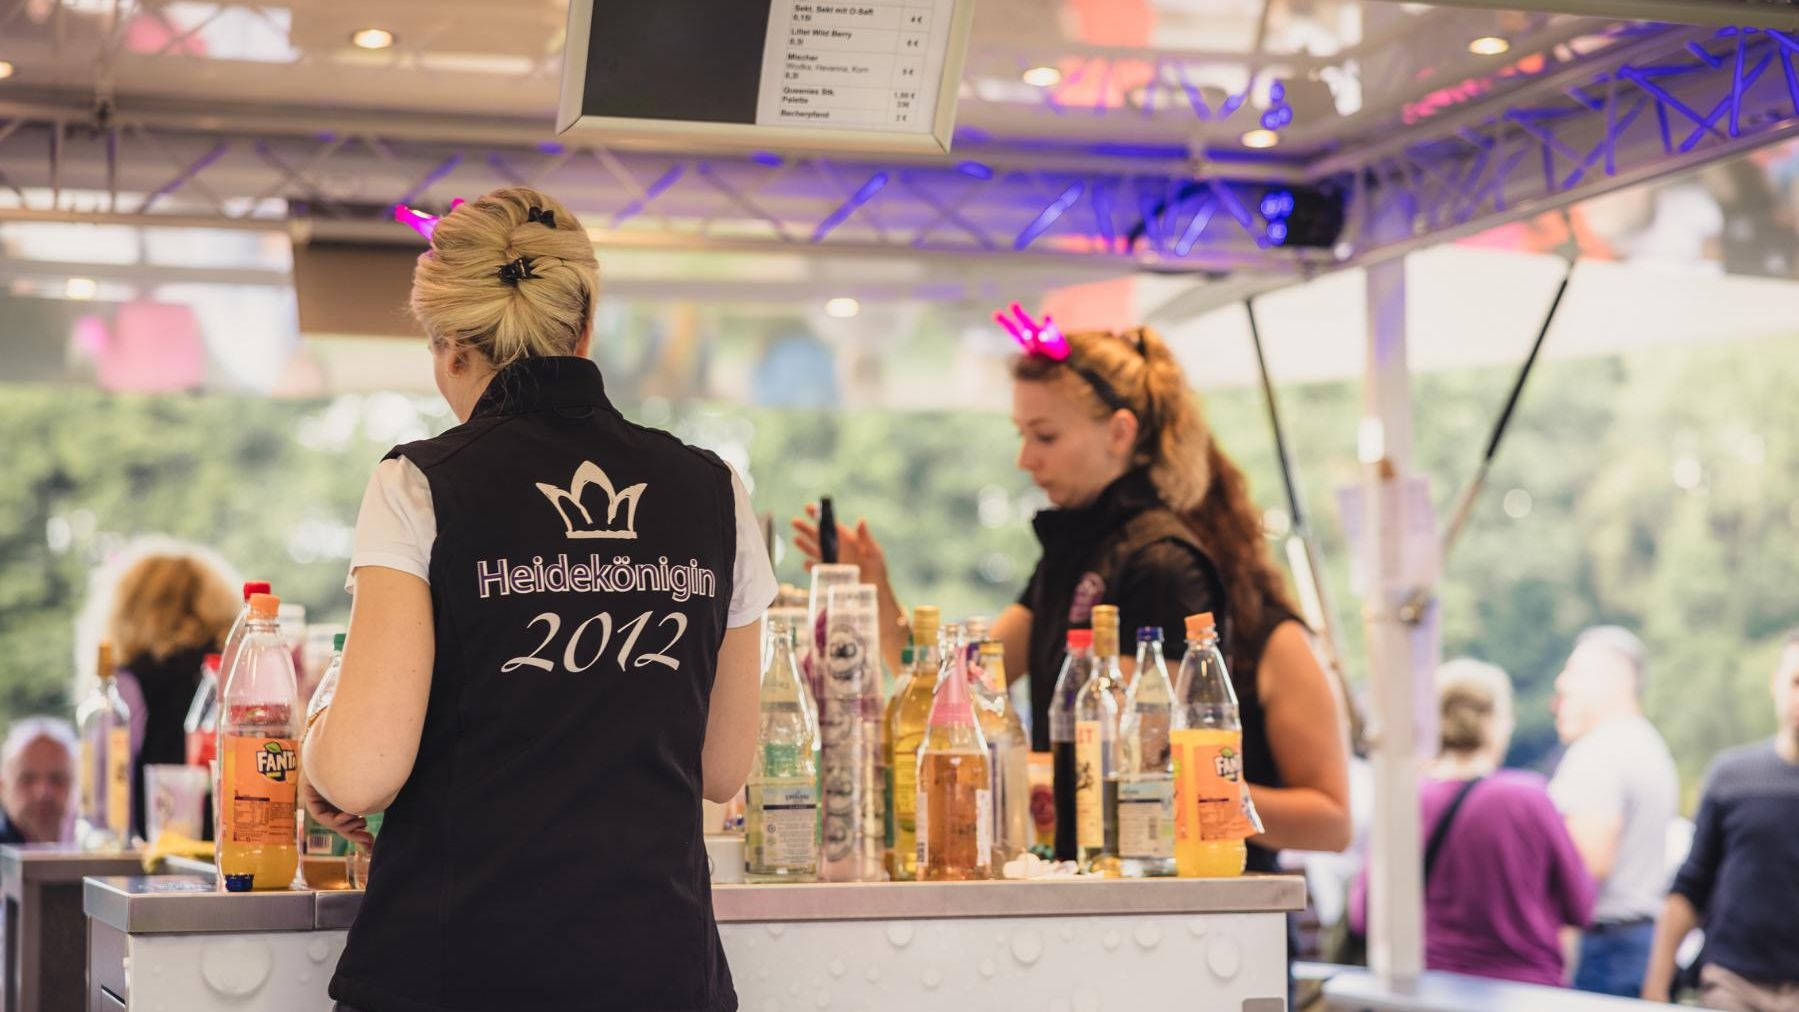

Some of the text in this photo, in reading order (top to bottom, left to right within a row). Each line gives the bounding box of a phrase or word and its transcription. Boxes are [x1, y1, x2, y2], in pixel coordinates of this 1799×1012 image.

[832, 30, 852, 39] Berry
[477, 554, 716, 603] Heidekönigin
[501, 611, 688, 673] 2012
